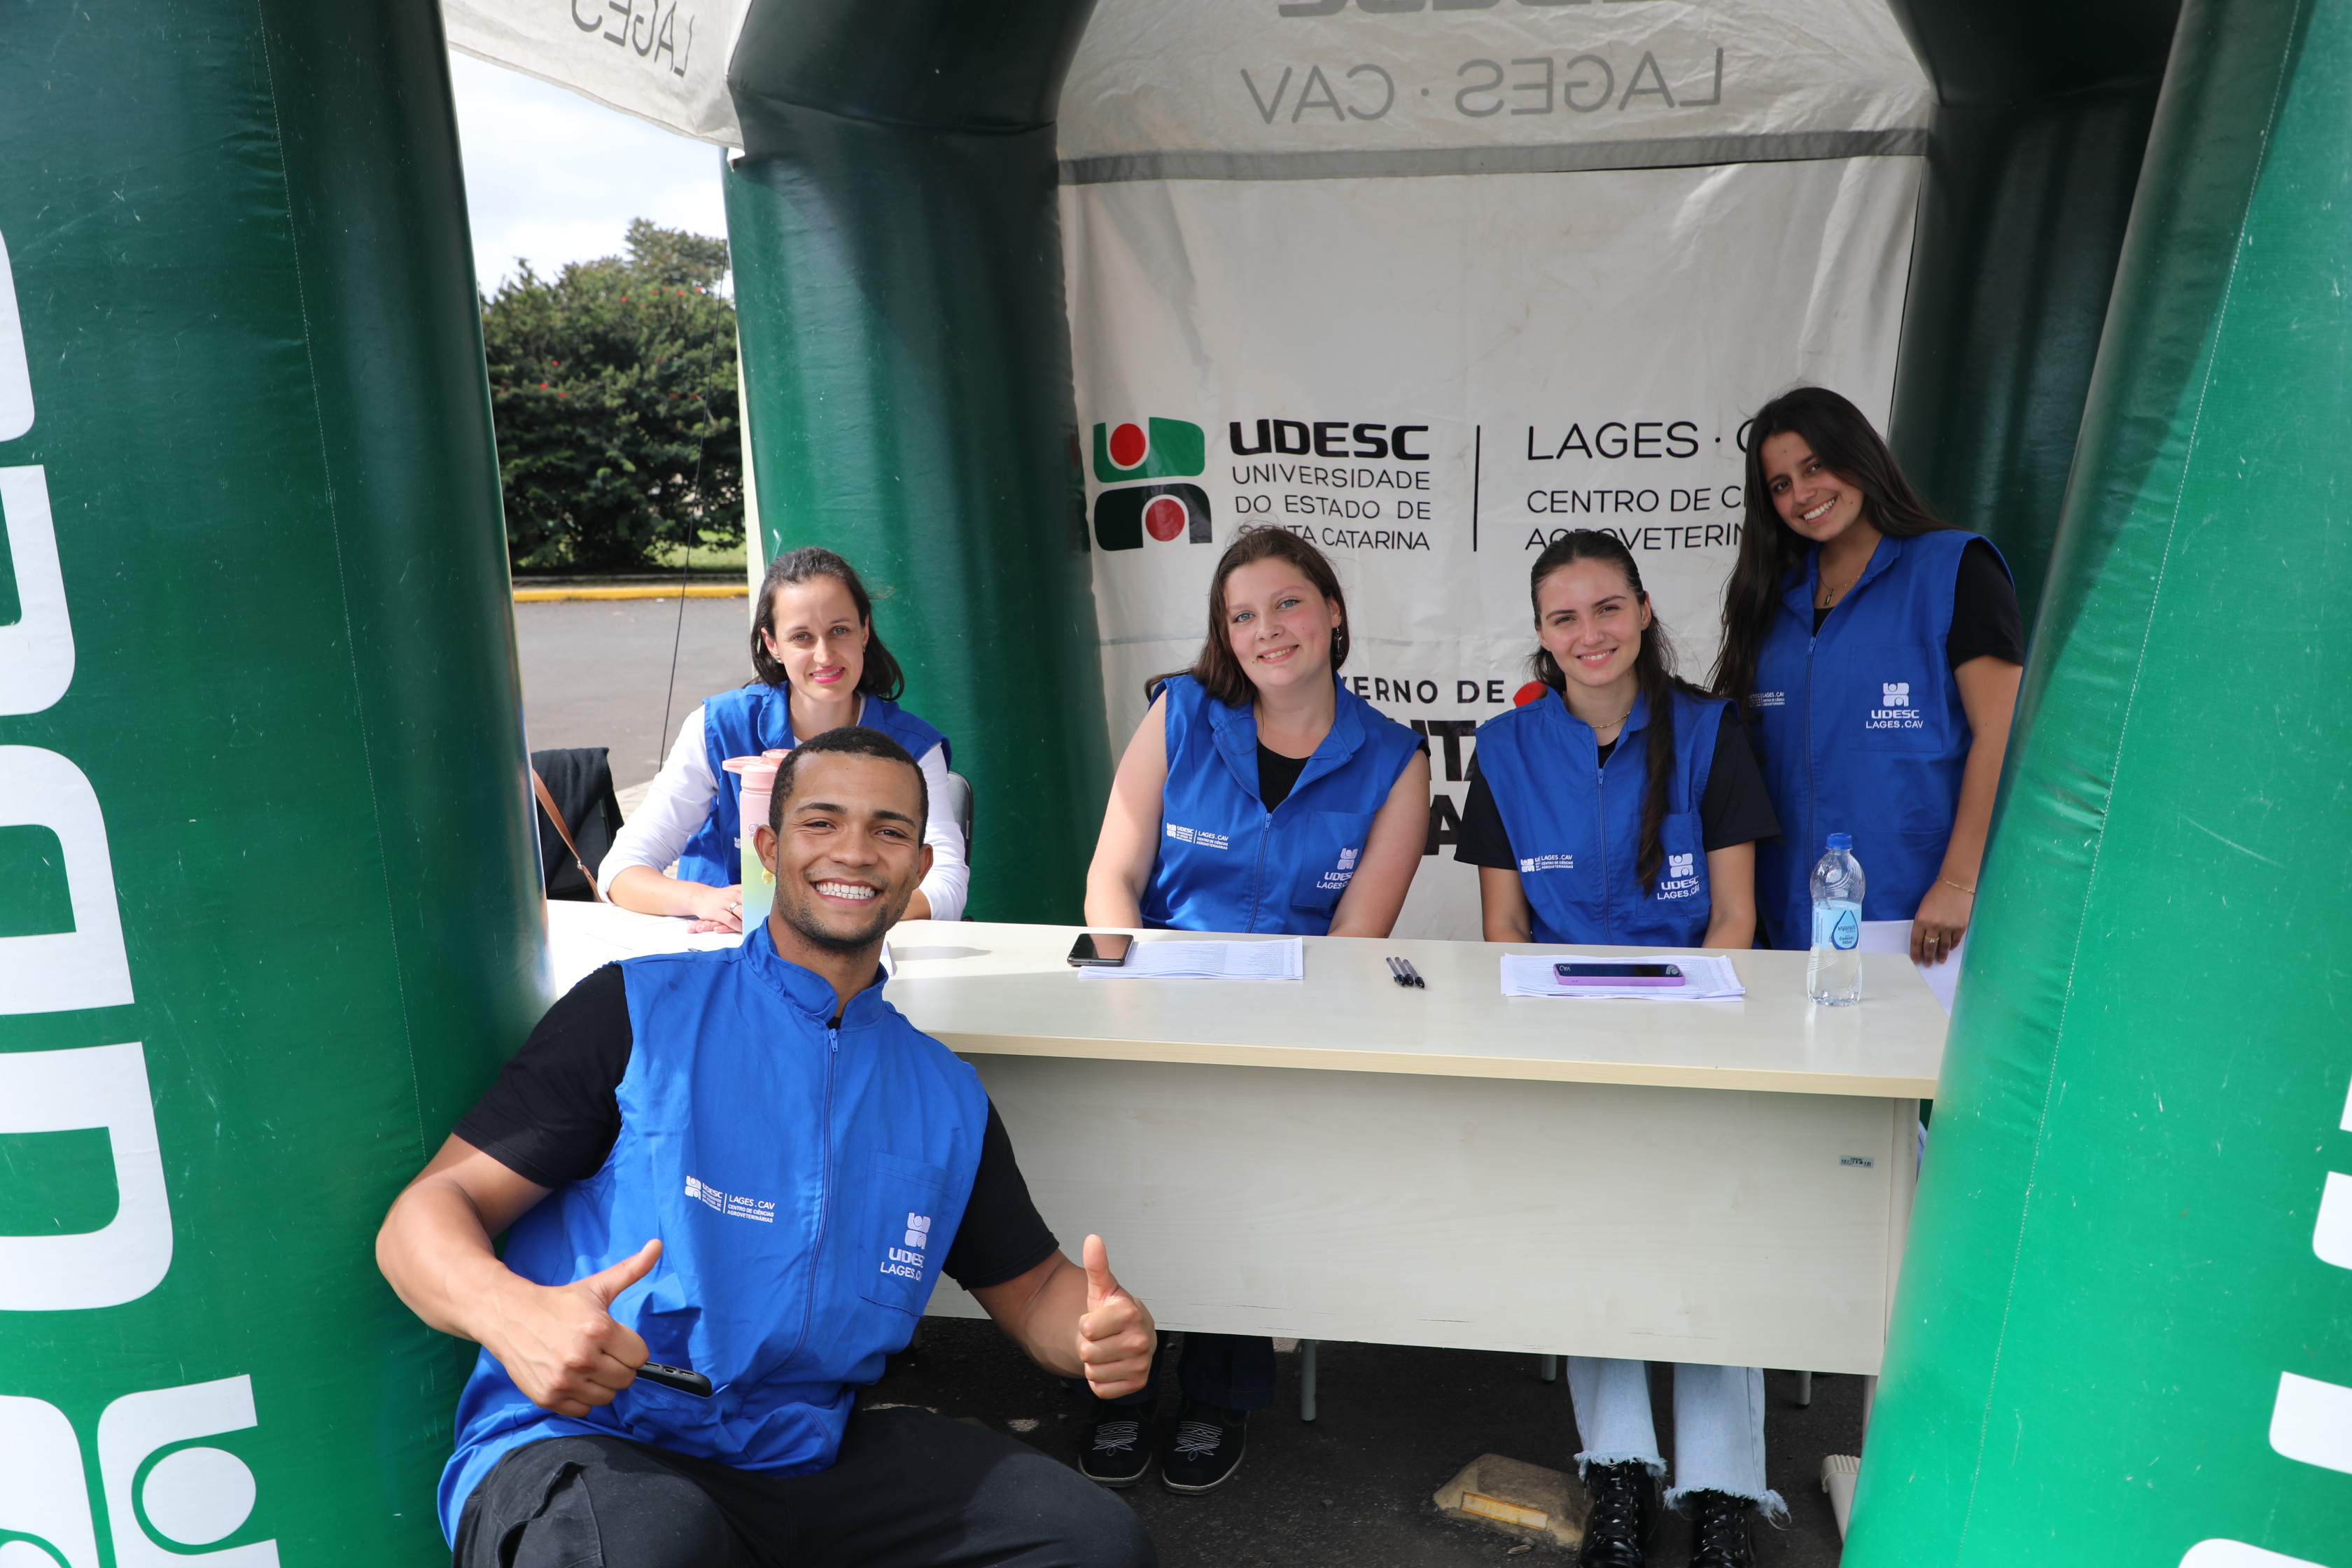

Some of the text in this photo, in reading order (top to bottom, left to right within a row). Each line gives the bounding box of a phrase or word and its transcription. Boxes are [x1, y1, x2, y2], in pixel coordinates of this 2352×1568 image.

[1229, 419, 1429, 460] UDESC
[1528, 421, 1699, 460] LAGES
[1233, 463, 1429, 489] UNIVERSIDADE
[1236, 495, 1430, 519] DO ESTADO DE
[1527, 490, 1659, 513] CENTRO
[1671, 488, 1711, 511] DE
[1322, 528, 1430, 550] CATARINA
[1342, 676, 1505, 704] ERNO DE
[1871, 709, 1919, 719] UDESC
[1661, 875, 1699, 890] UDESC
[702, 1182, 723, 1198] UDESC
[728, 1204, 746, 1212] CENTRO
